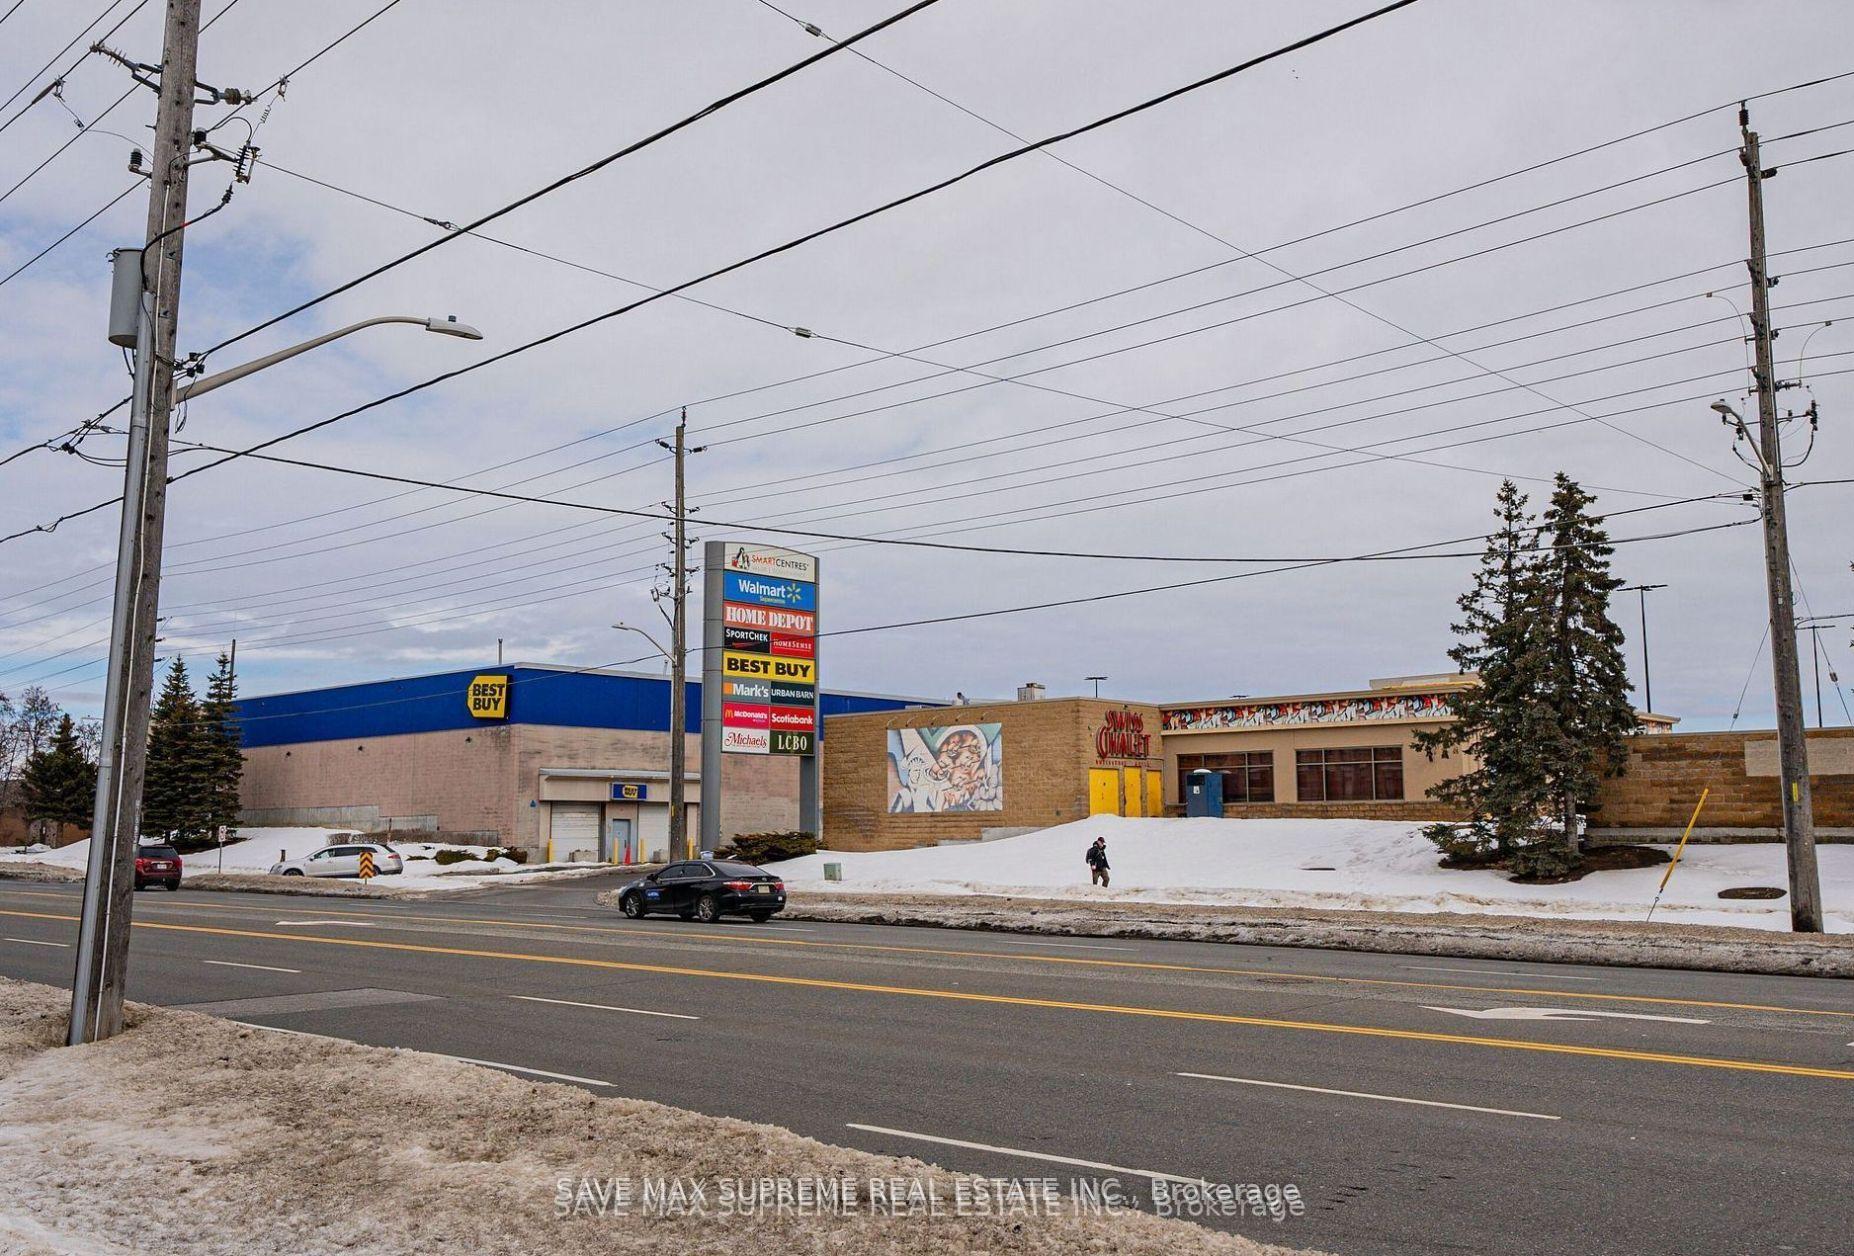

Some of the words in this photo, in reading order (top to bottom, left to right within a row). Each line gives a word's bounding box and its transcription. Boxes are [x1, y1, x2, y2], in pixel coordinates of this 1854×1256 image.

[751, 554, 807, 571] SMARTCENTRES
[738, 579, 786, 598] Walmart
[726, 606, 767, 626] HOME
[769, 611, 814, 631] DEPOT
[727, 657, 771, 675] BEST
[775, 661, 811, 678] BUY
[473, 683, 506, 697] BEST
[733, 683, 769, 698] Mark's
[771, 689, 796, 698] URBAN
[796, 691, 814, 699] BARN
[473, 697, 502, 711] BUY
[771, 713, 813, 725] Scotiabank
[725, 731, 768, 749] Michaels
[778, 734, 808, 751] LCBO
[1096, 726, 1151, 759] CHALET
